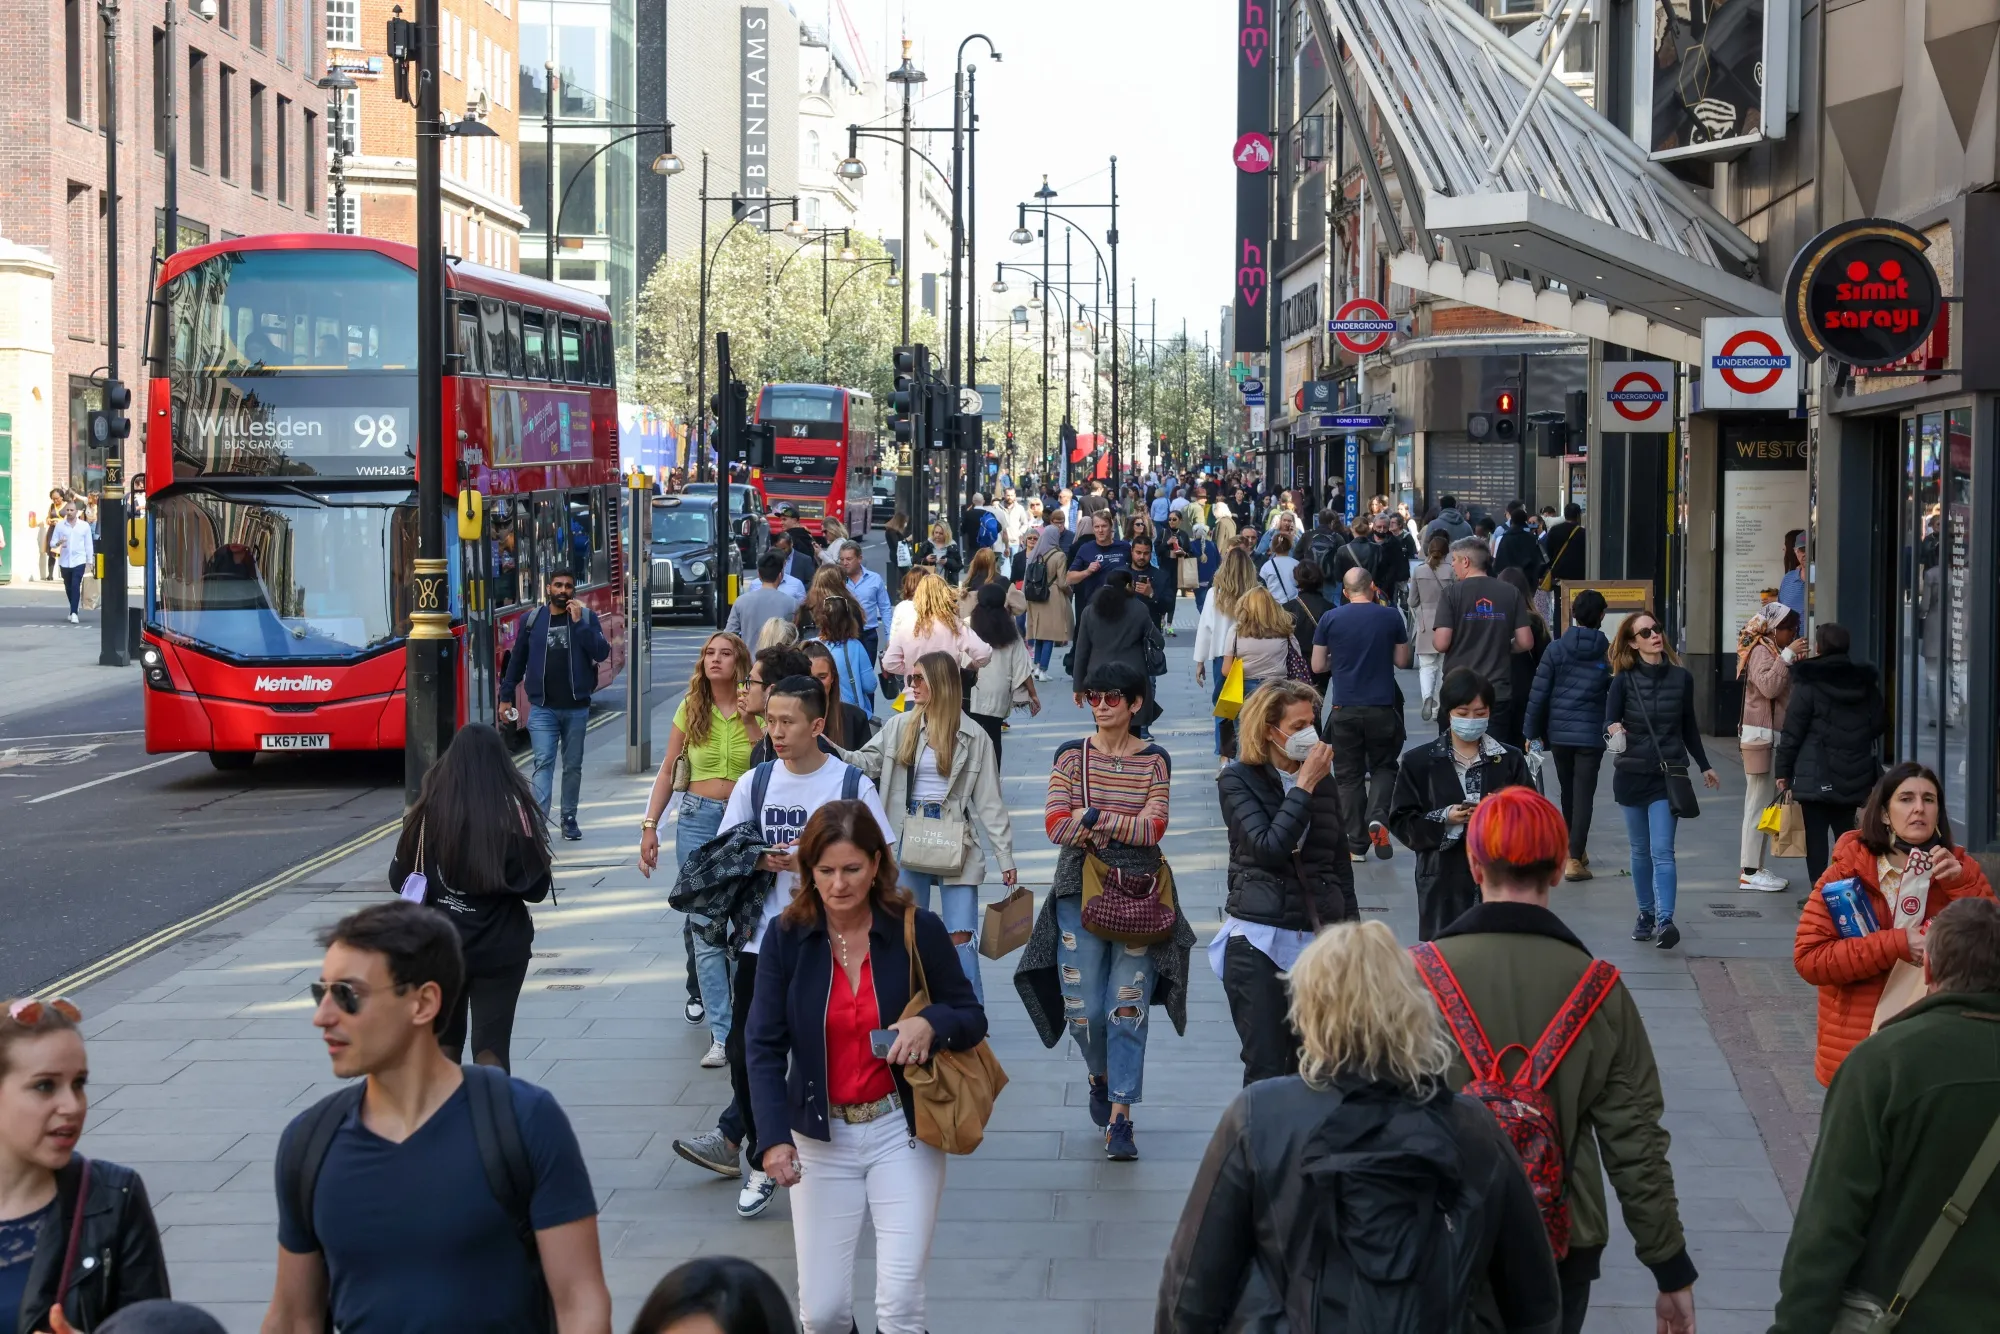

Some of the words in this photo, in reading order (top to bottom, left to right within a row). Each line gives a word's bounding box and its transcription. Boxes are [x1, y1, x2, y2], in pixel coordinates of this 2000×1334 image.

[1240, 0, 1268, 68] hmv
[746, 17, 766, 223] DEBENHAMS
[1238, 238, 1266, 307] hmv
[1836, 260, 1909, 300] simit
[1331, 322, 1394, 330] UNDERGROUND
[1716, 358, 1787, 366] UNDERGROUND
[196, 413, 322, 437] Willesden
[353, 414, 397, 449] 98
[793, 425, 807, 437] 94
[224, 439, 245, 450] BUS
[249, 439, 294, 450] GARAGE
[1346, 435, 1356, 482] MONEY
[355, 466, 406, 476] VWH2413
[254, 675, 333, 692] Metroline
[266, 735, 298, 747] LK67
[301, 735, 324, 747] ENY
[764, 804, 808, 827] DO
[924, 830, 943, 838] THE
[909, 836, 933, 844] TOTE
[936, 838, 957, 847] BAG
